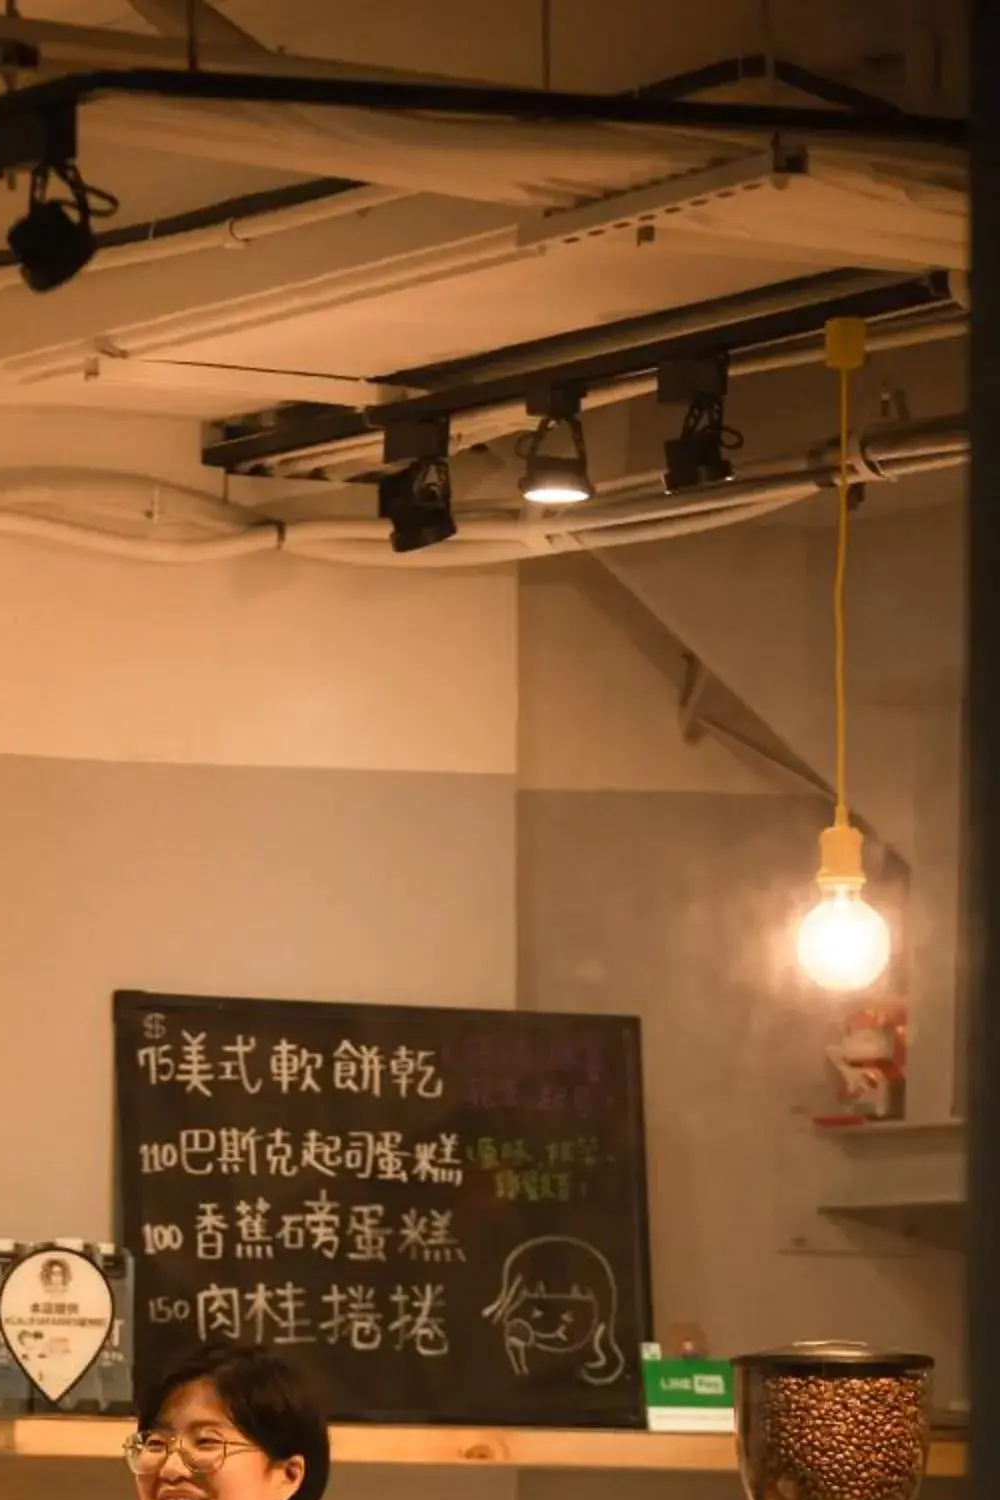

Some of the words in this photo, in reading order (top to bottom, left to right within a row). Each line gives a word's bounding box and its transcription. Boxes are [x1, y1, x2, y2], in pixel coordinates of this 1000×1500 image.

[137, 1043, 175, 1085] 75
[176, 1028, 443, 1099] 美式軟餅乾
[139, 1142, 178, 1175] 110
[179, 1127, 464, 1187] 巴斯克起司蛋糕
[142, 1223, 183, 1255] 100
[194, 1188, 468, 1262] 香蕉磅蛋糕
[148, 1297, 190, 1323] 150
